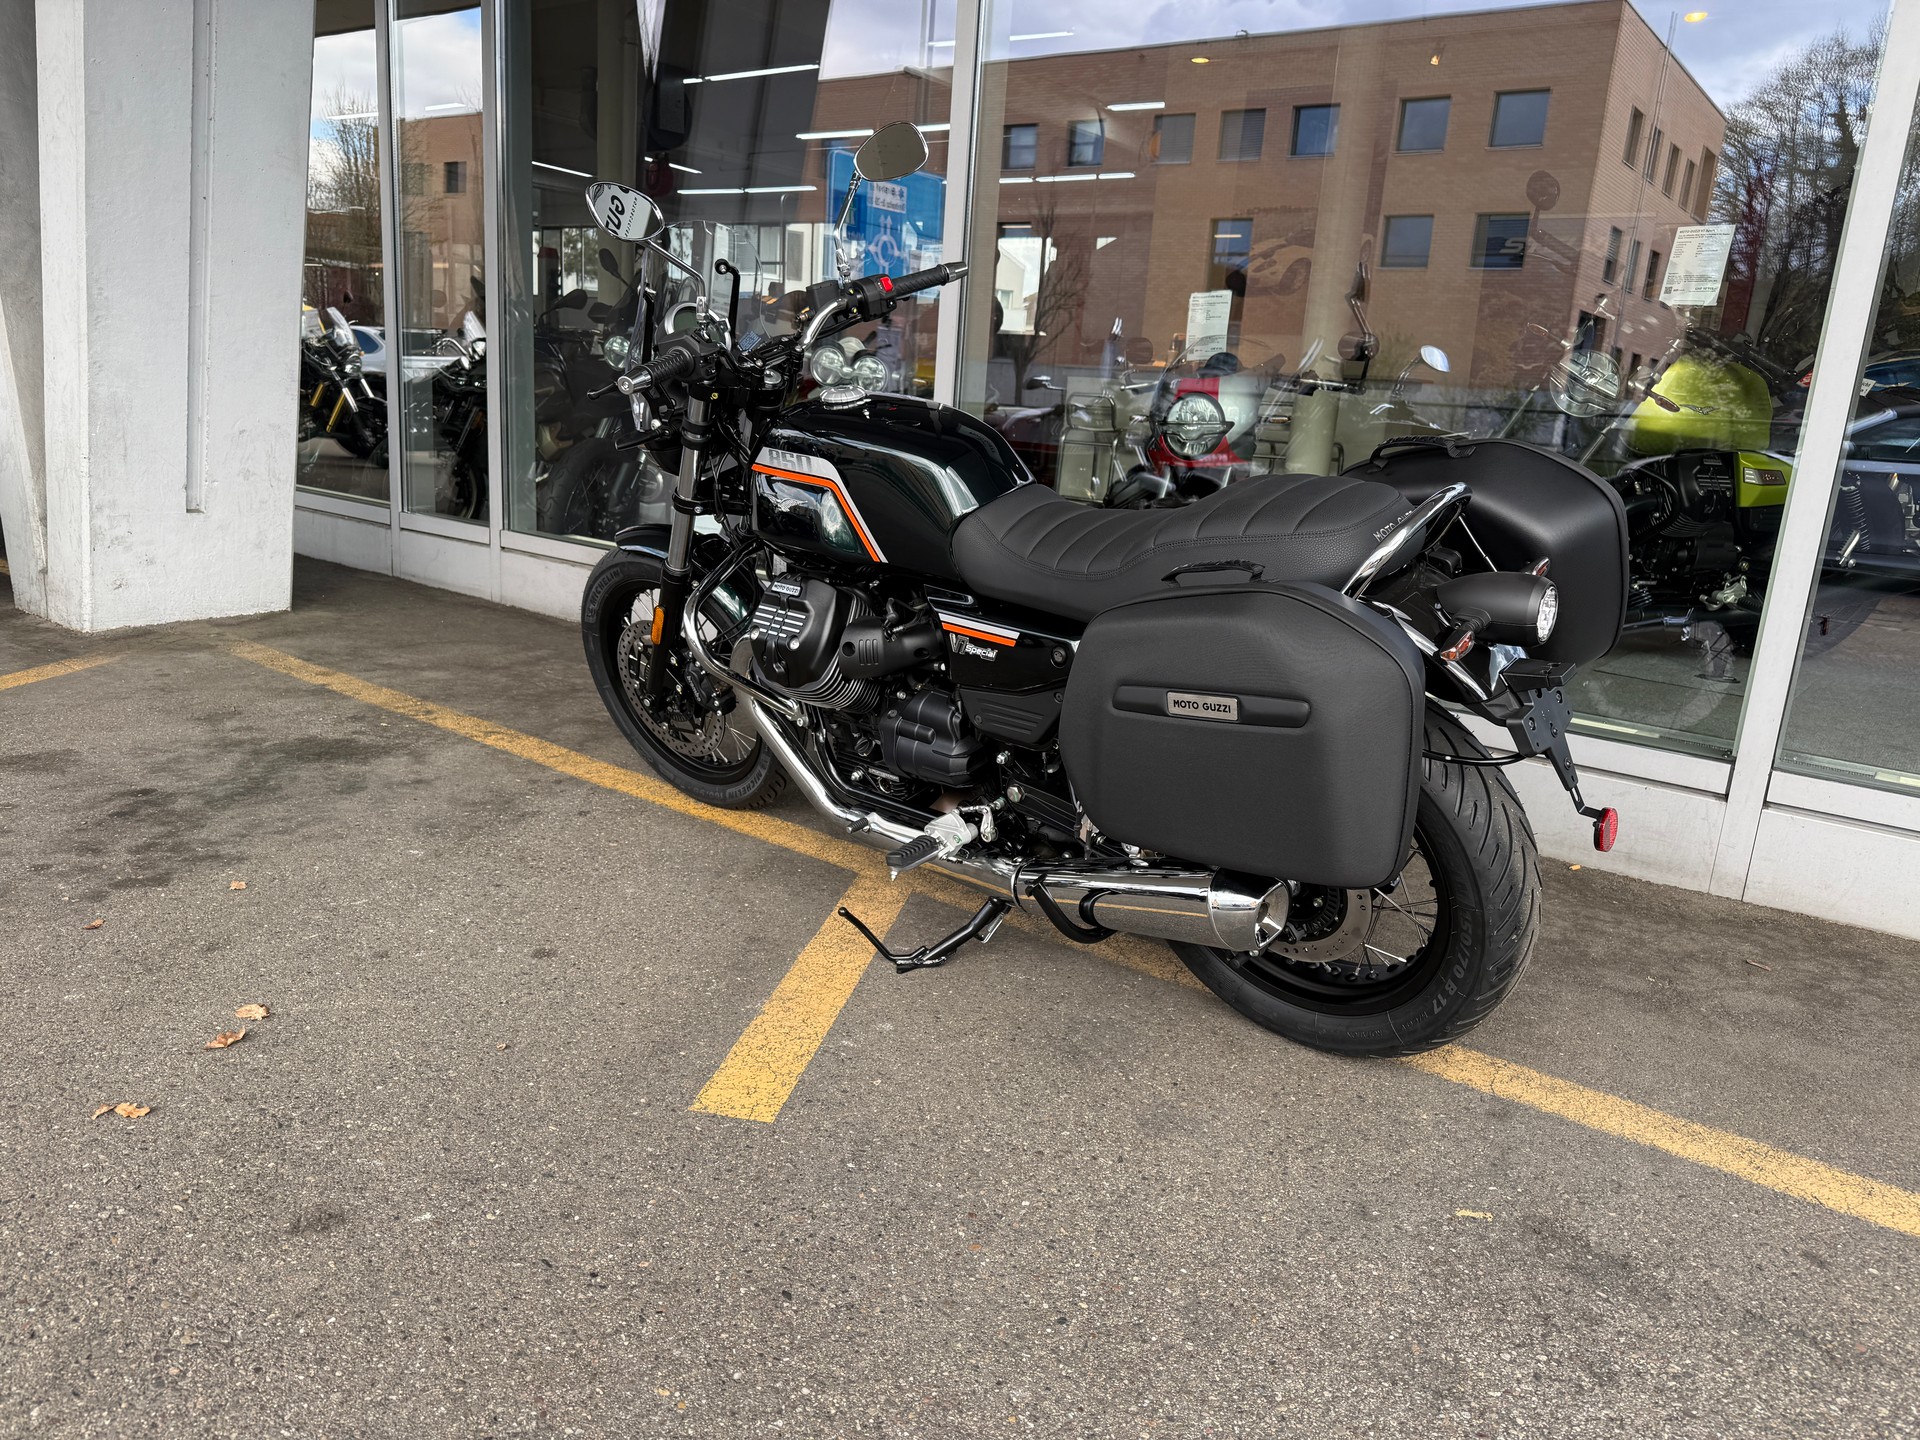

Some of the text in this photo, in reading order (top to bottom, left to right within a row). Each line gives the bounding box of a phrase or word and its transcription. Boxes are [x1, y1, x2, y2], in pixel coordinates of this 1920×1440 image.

[590, 569, 620, 607] MICHELIN
[965, 643, 998, 659] Special
[1173, 699, 1231, 713] MOTO GUZZI
[728, 770, 763, 799] MICHELIN
[1432, 995, 1447, 1015] 17
